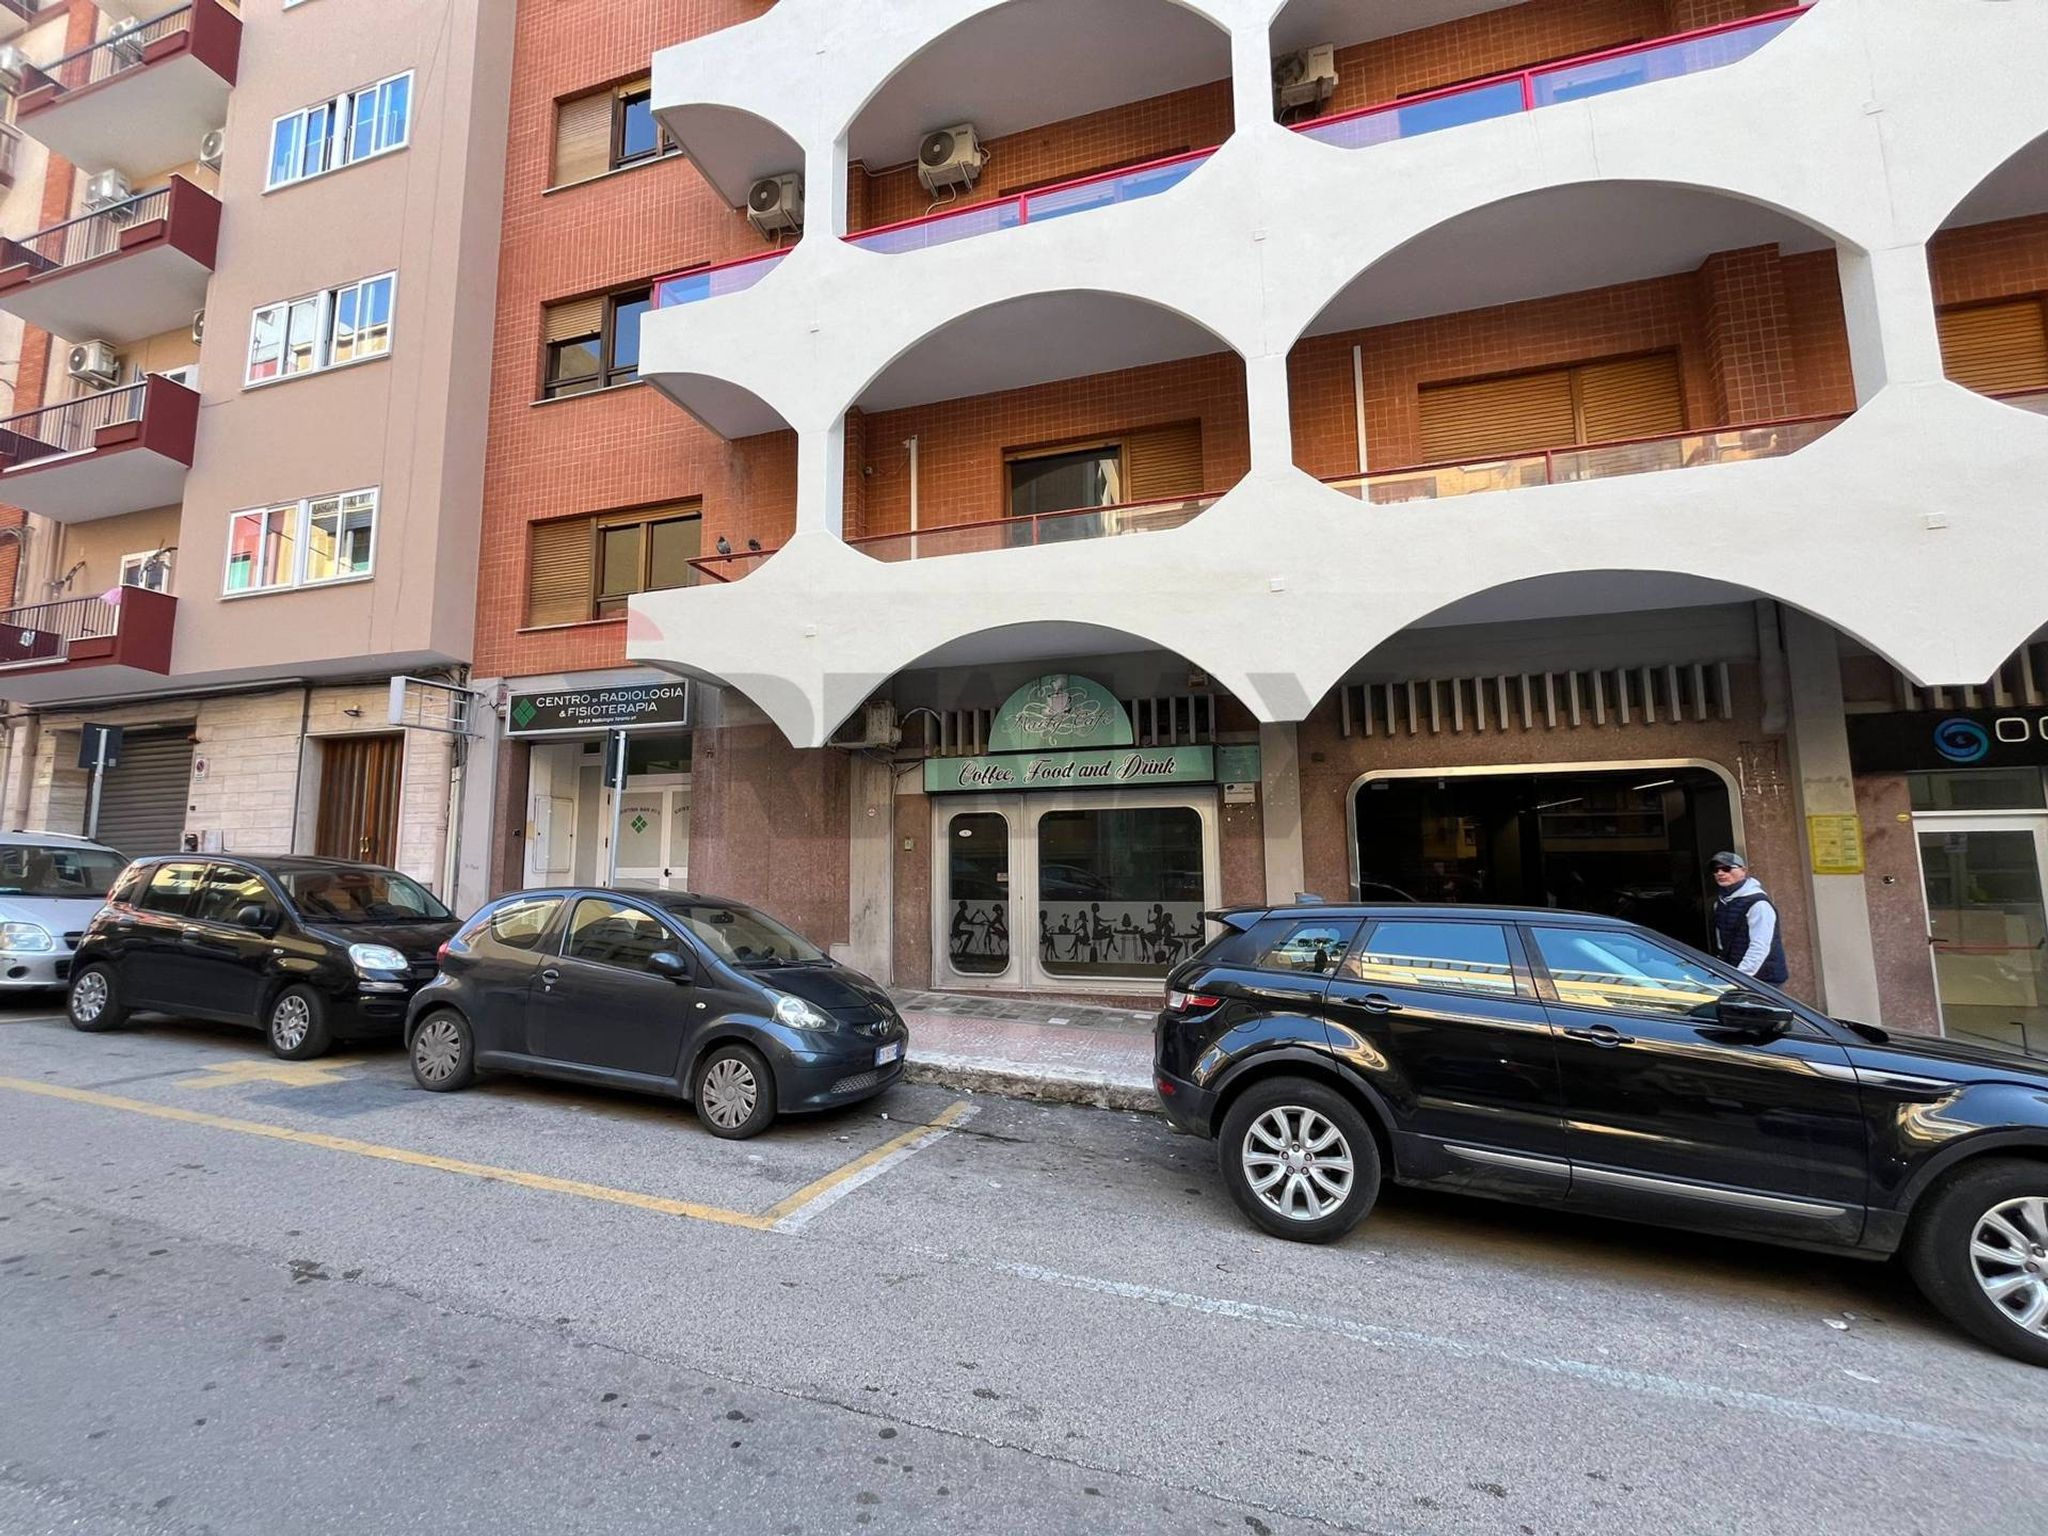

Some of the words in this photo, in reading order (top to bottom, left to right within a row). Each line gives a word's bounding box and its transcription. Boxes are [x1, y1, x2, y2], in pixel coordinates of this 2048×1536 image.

[535, 694, 591, 708] CENTRO
[600, 687, 684, 702] RADIOLOGIA
[568, 702, 658, 717] FISIOTERAPIA
[958, 759, 1015, 786] Coffee,
[1023, 758, 1073, 785] Food
[1078, 759, 1112, 779] and
[1115, 754, 1177, 780] Drink
